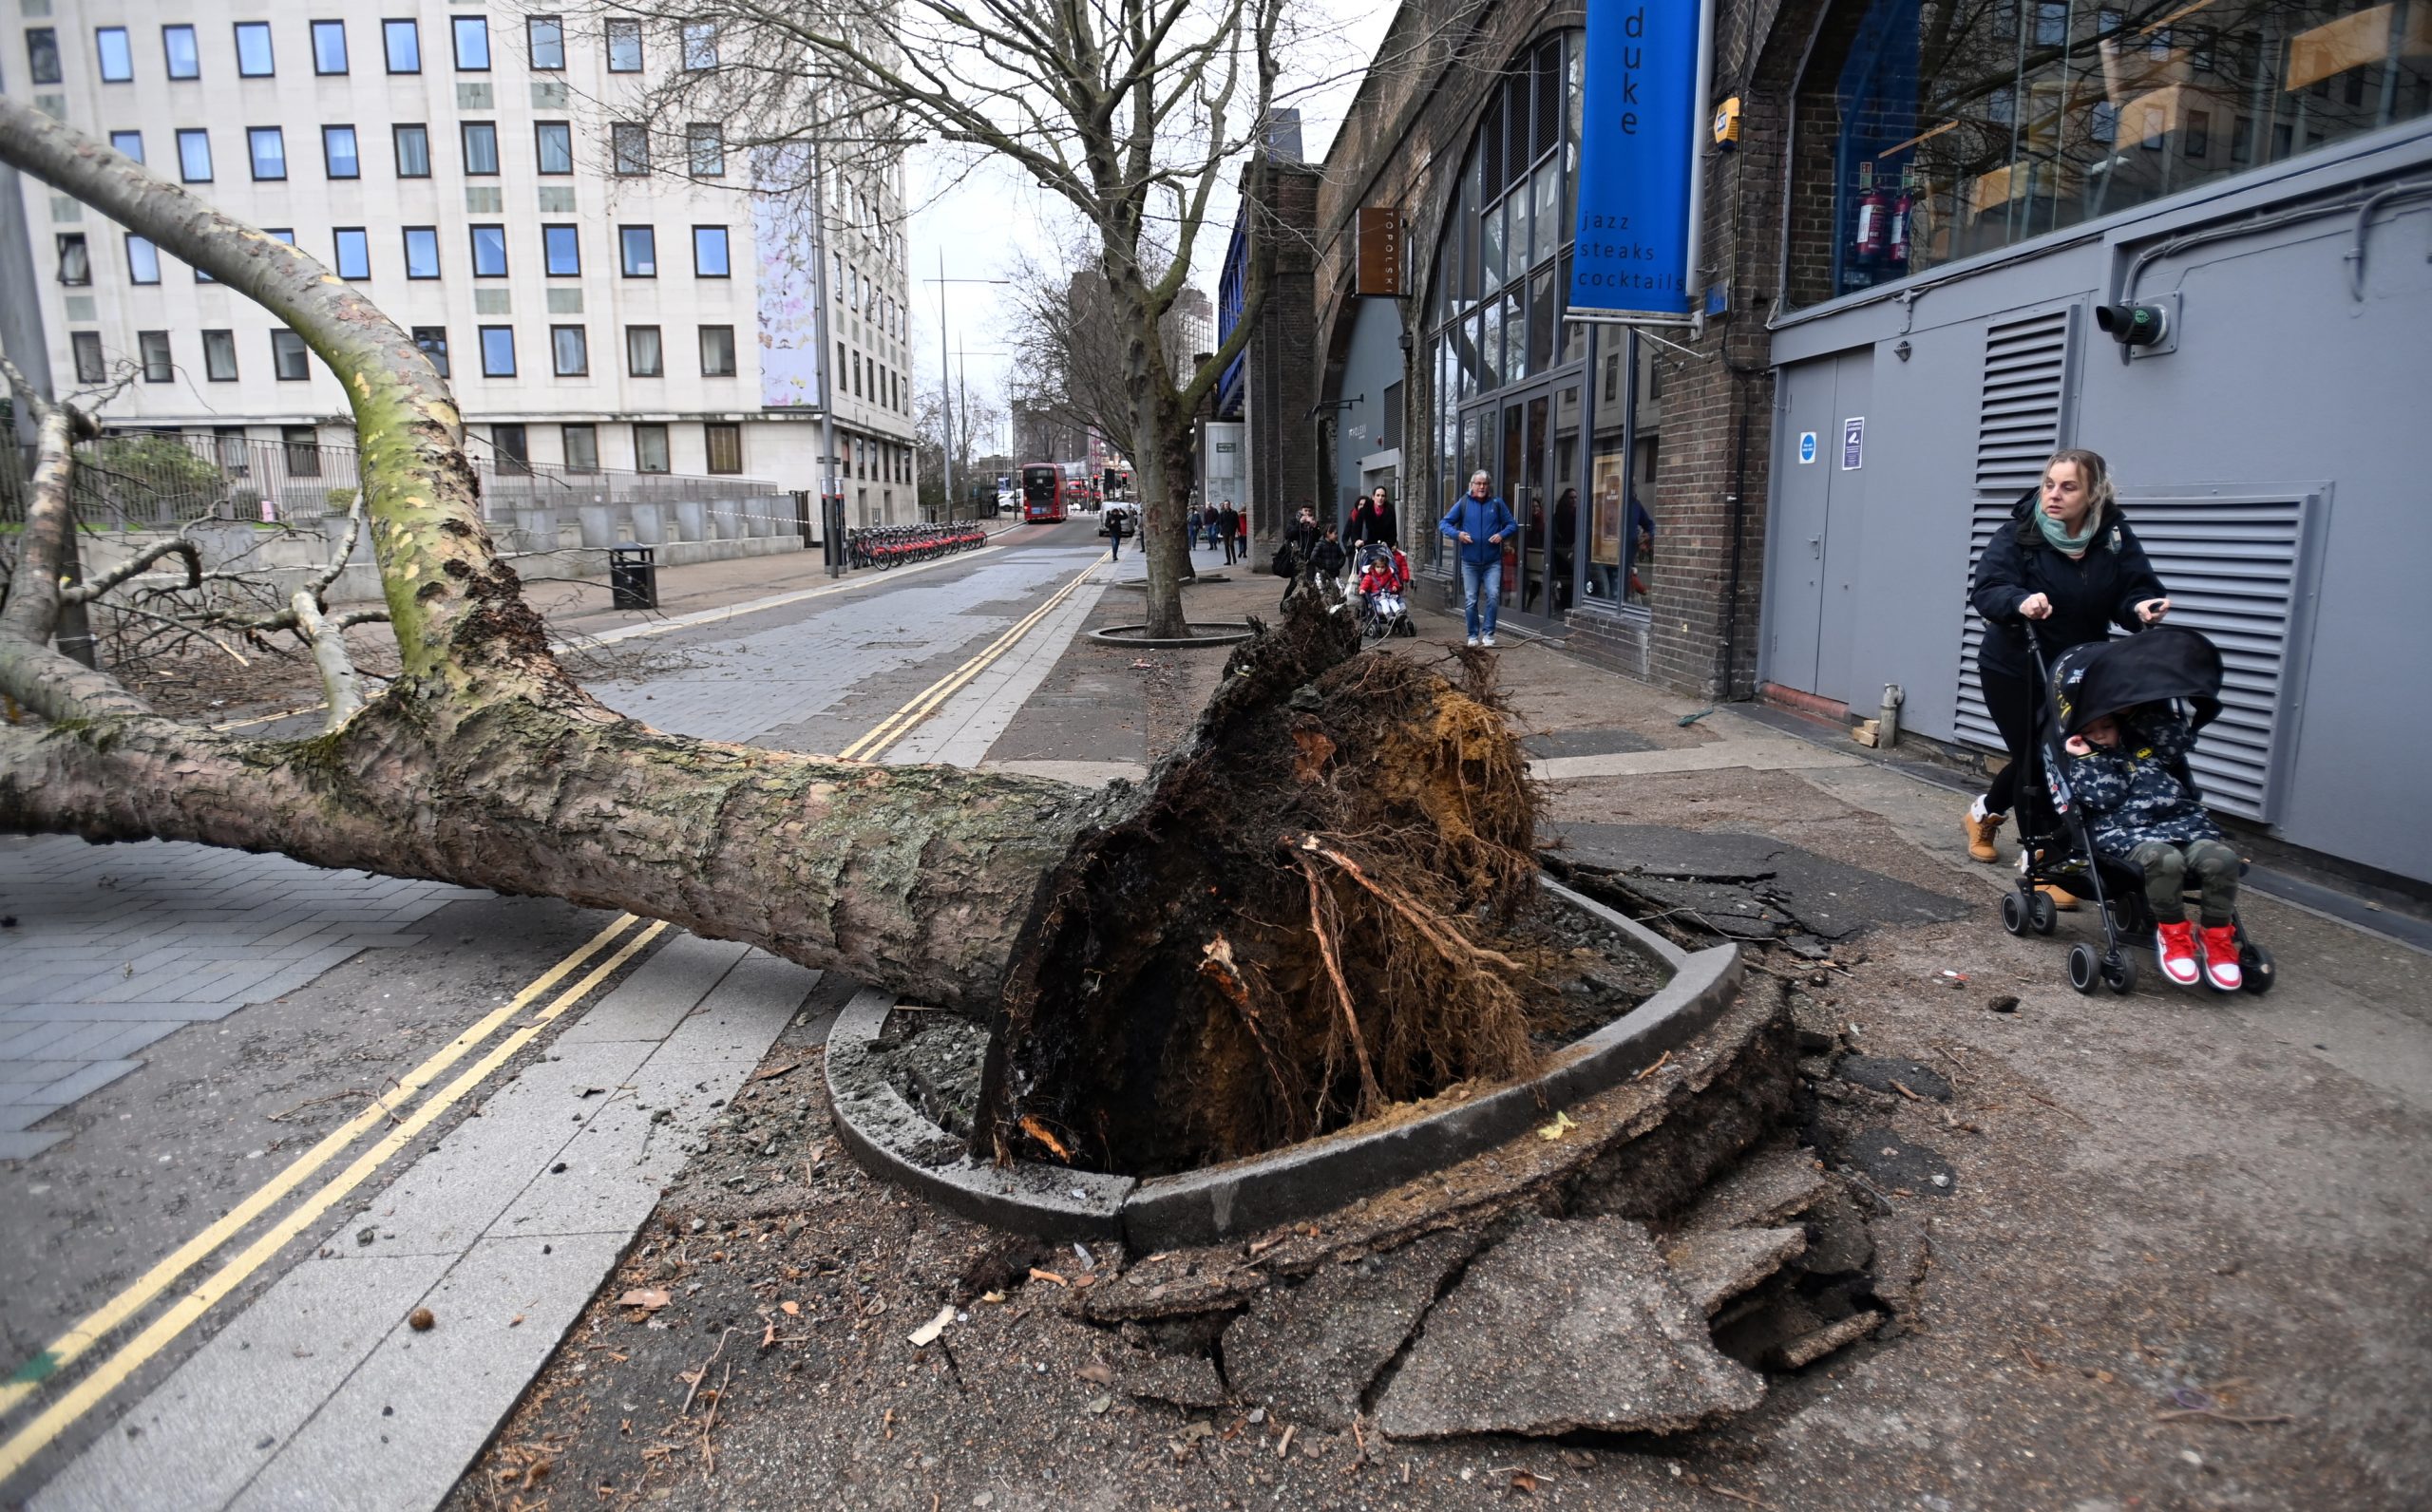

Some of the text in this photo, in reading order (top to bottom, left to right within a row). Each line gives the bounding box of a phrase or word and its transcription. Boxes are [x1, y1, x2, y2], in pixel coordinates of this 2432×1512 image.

[1621, 6, 1644, 135] duke
[1582, 210, 1628, 232] jazz
[1385, 212, 1394, 293] TOPOLSKI
[1580, 242, 1654, 260] steaks
[1579, 270, 1683, 292] cocktails
